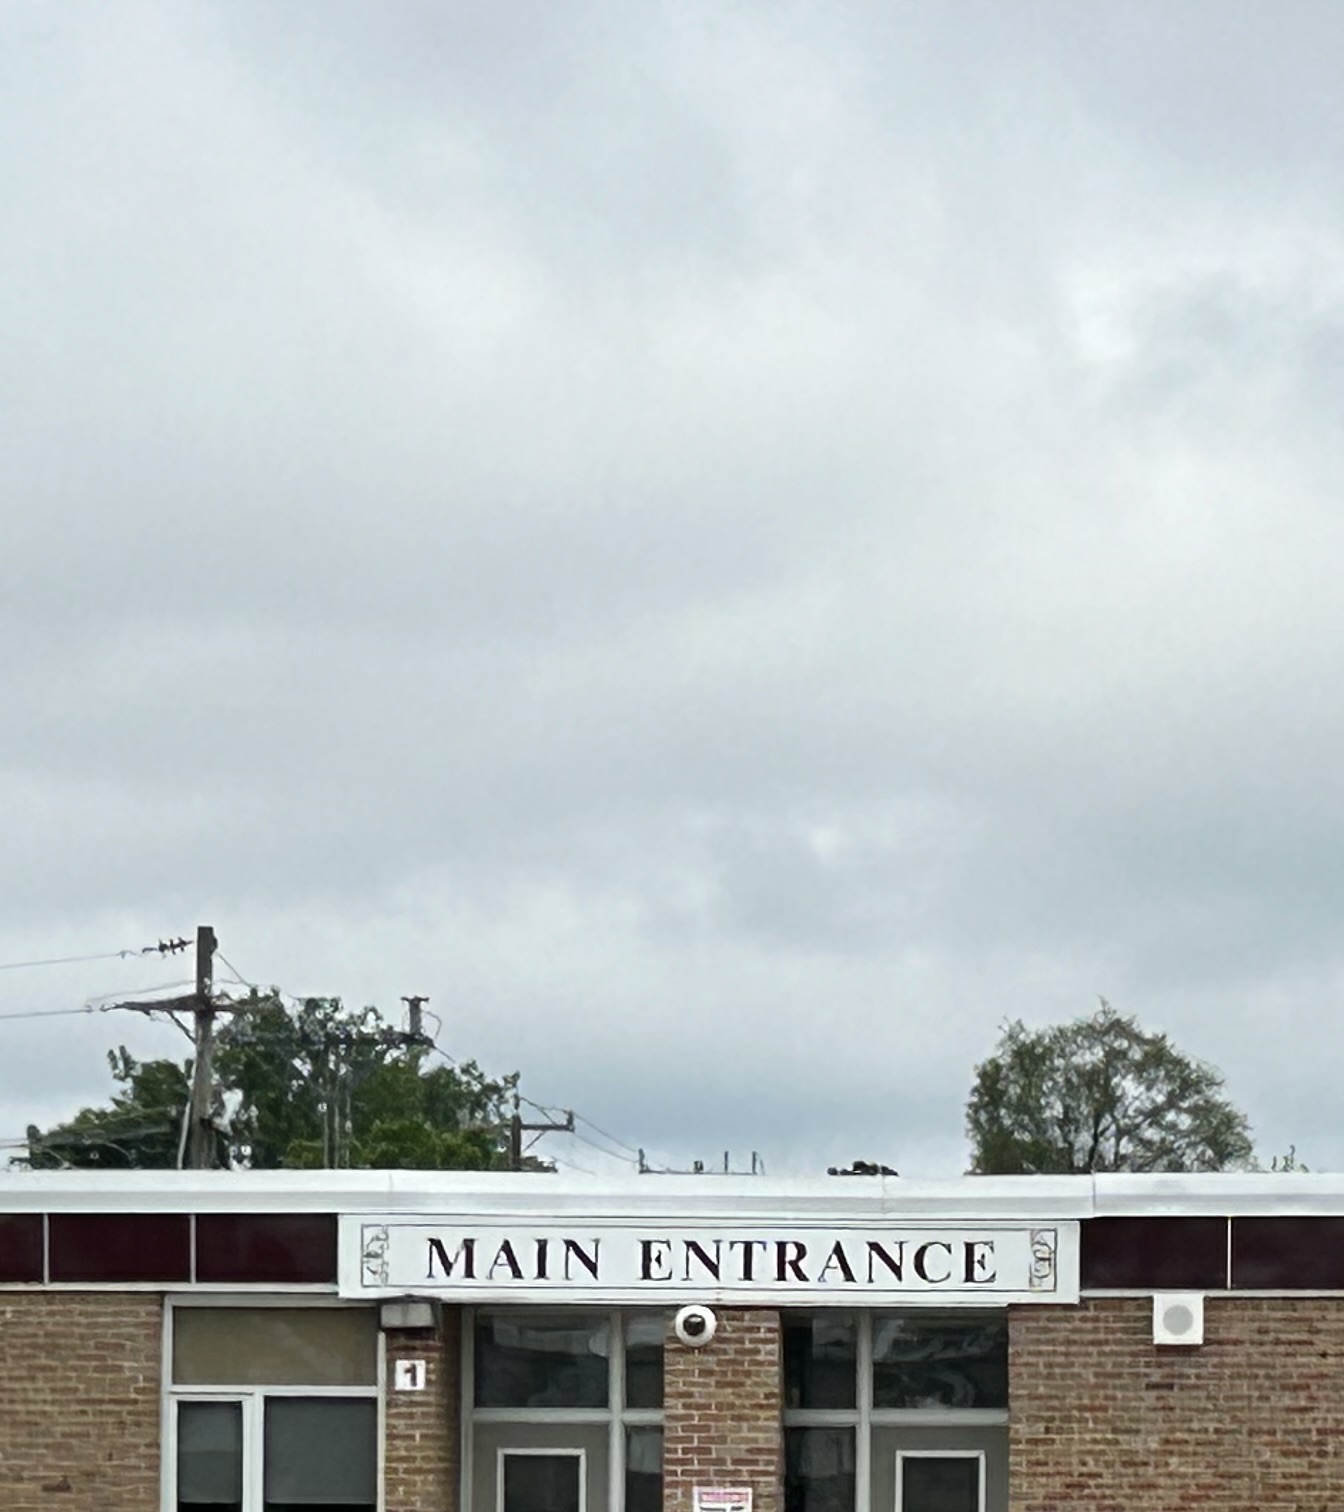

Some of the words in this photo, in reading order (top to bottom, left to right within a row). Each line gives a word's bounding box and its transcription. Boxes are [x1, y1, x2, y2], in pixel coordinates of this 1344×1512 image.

[426, 1237, 601, 1281] MAIN
[636, 1239, 997, 1284] ENTRANCE
[404, 1363, 418, 1387] 1
